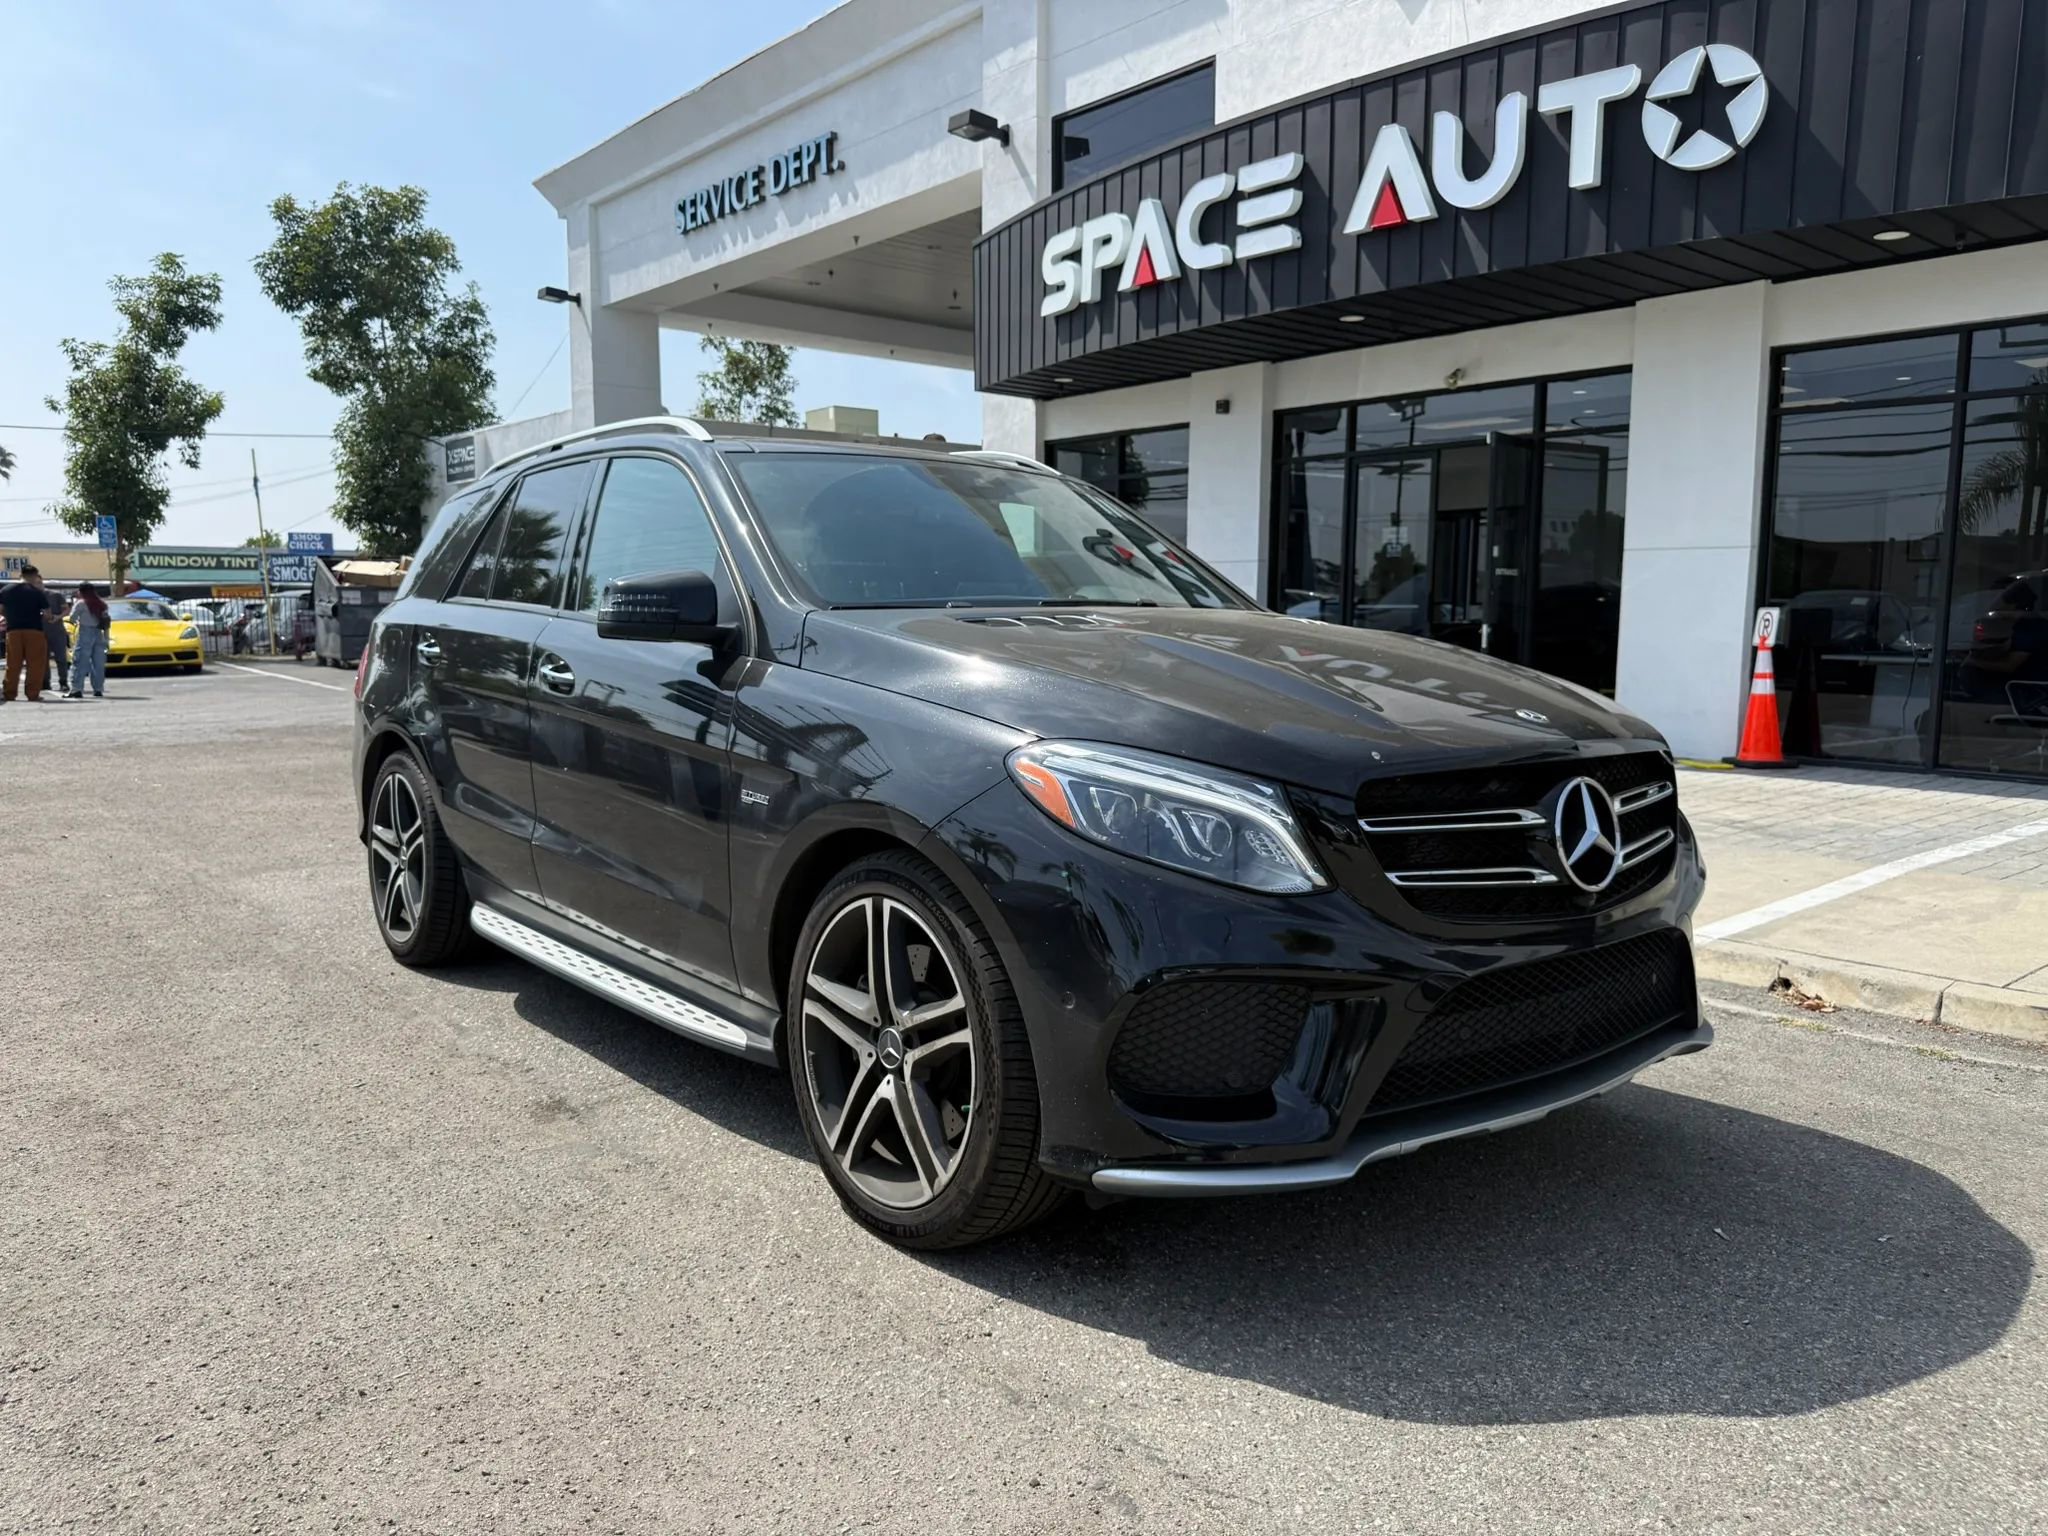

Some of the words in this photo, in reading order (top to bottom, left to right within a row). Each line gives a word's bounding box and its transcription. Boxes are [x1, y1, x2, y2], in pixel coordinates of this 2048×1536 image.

[675, 165, 764, 234] SERVICE
[768, 131, 846, 196] DEPT.
[1041, 152, 1304, 317] SPACE
[1343, 43, 1769, 234] AUTO
[292, 533, 321, 541] SMOG
[289, 541, 324, 550] CHECK
[143, 554, 217, 567] WINDOW
[220, 556, 258, 568] TINT
[273, 566, 308, 581] SMOG
